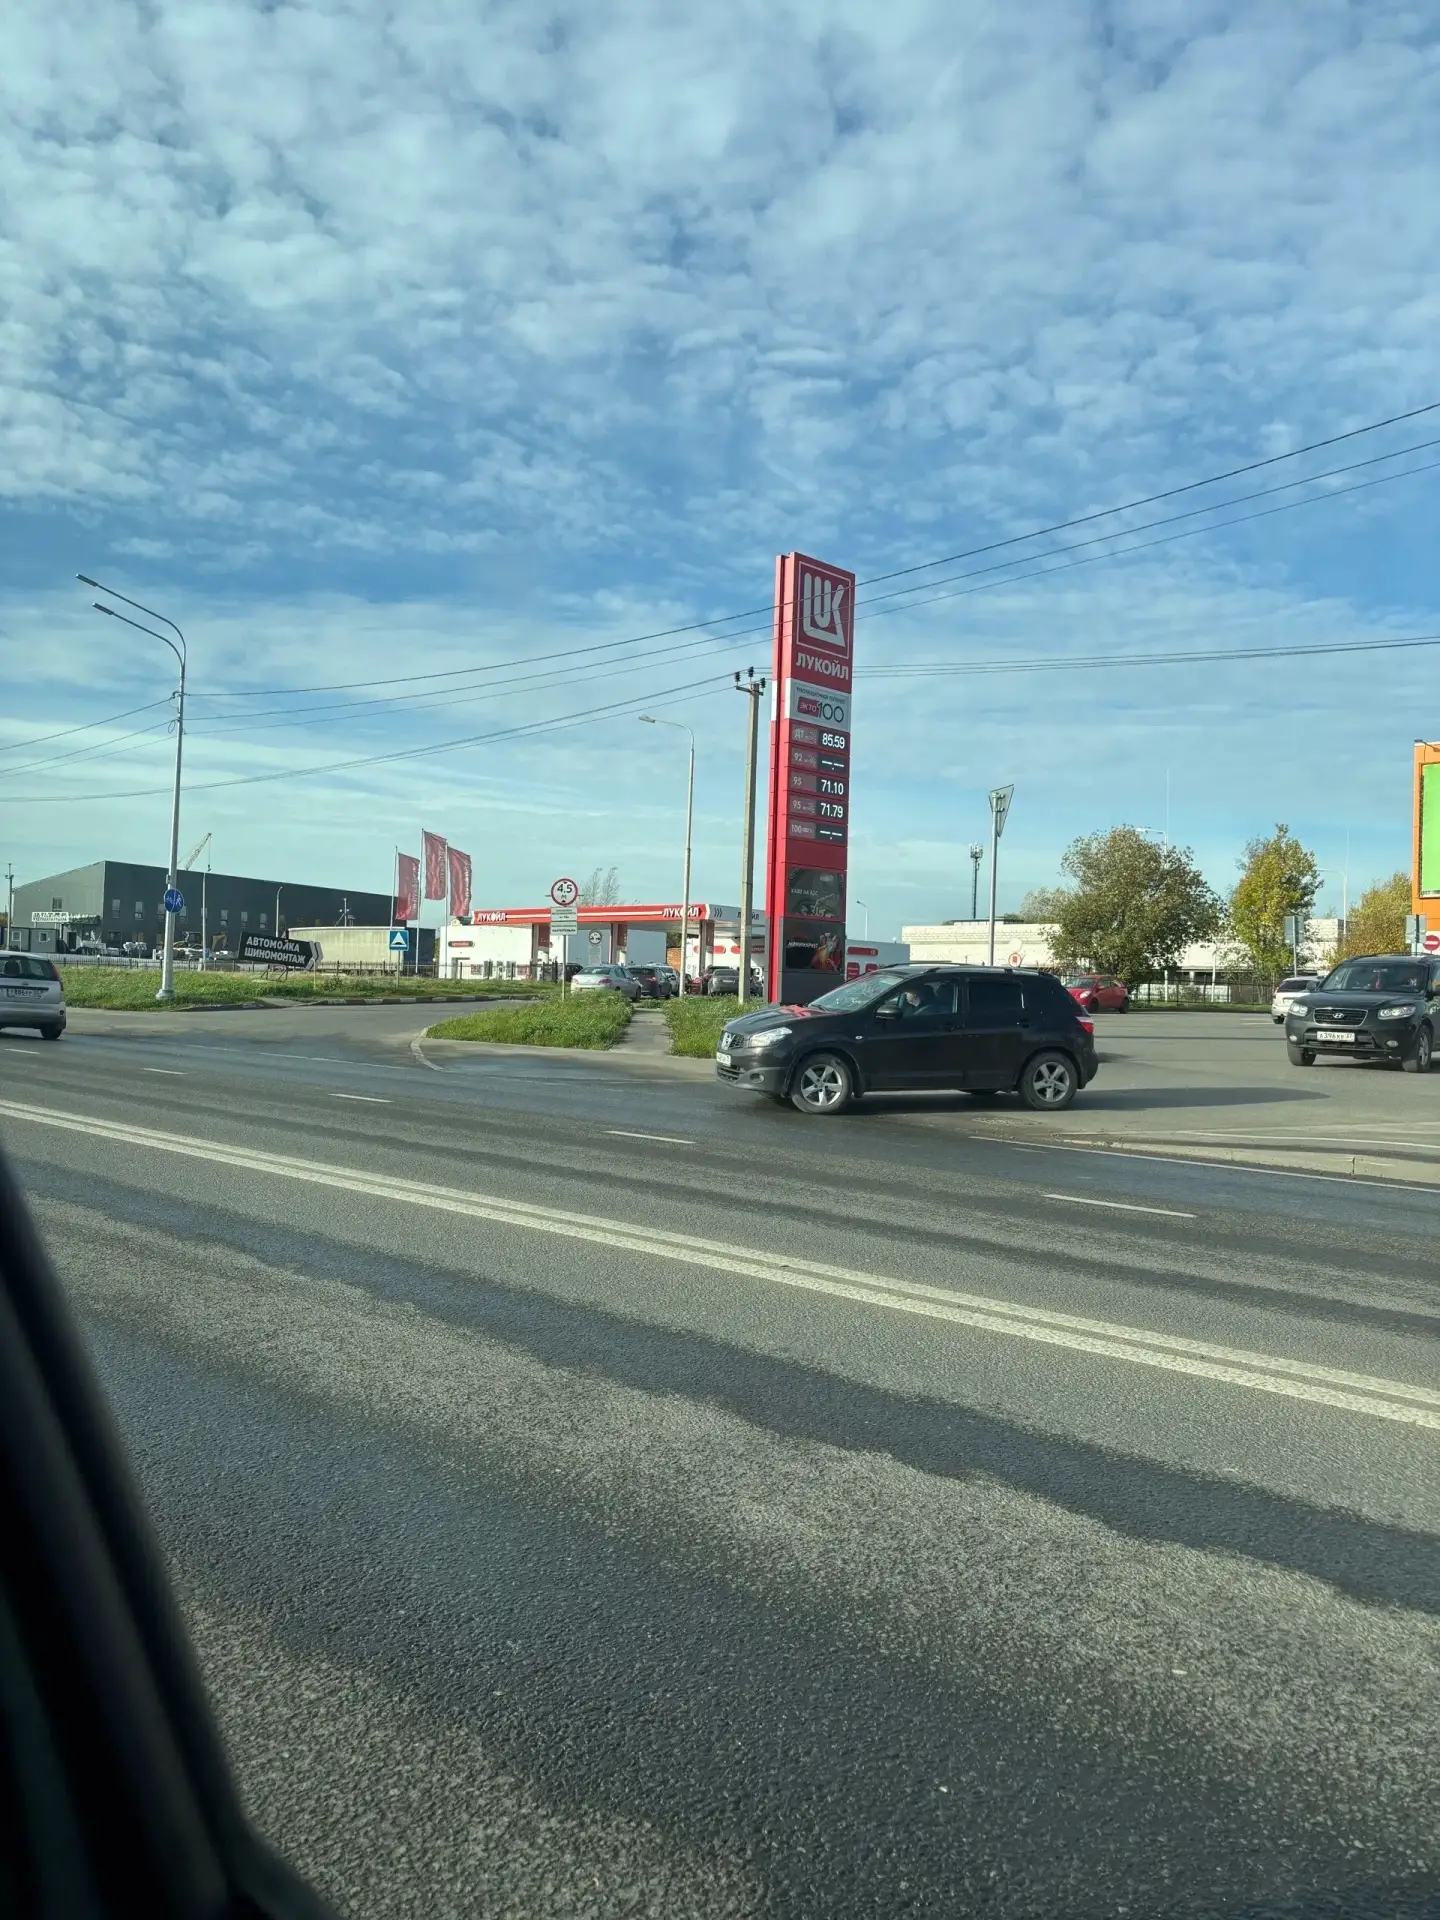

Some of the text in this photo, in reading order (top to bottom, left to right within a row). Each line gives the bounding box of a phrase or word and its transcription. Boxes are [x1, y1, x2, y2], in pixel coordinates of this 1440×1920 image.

[796, 652, 849, 680] ЛУКОЙЛ
[822, 733, 845, 749] 85.59
[794, 752, 802, 763] 92
[792, 776, 844, 795] 95 71.10
[792, 800, 801, 810] 95
[820, 802, 844, 818] 71.79
[477, 910, 506, 922] ЛУКОЙЛ
[246, 936, 300, 952] АВТОМОЙКА
[244, 947, 306, 964] ШИНОМОНТАЖ
